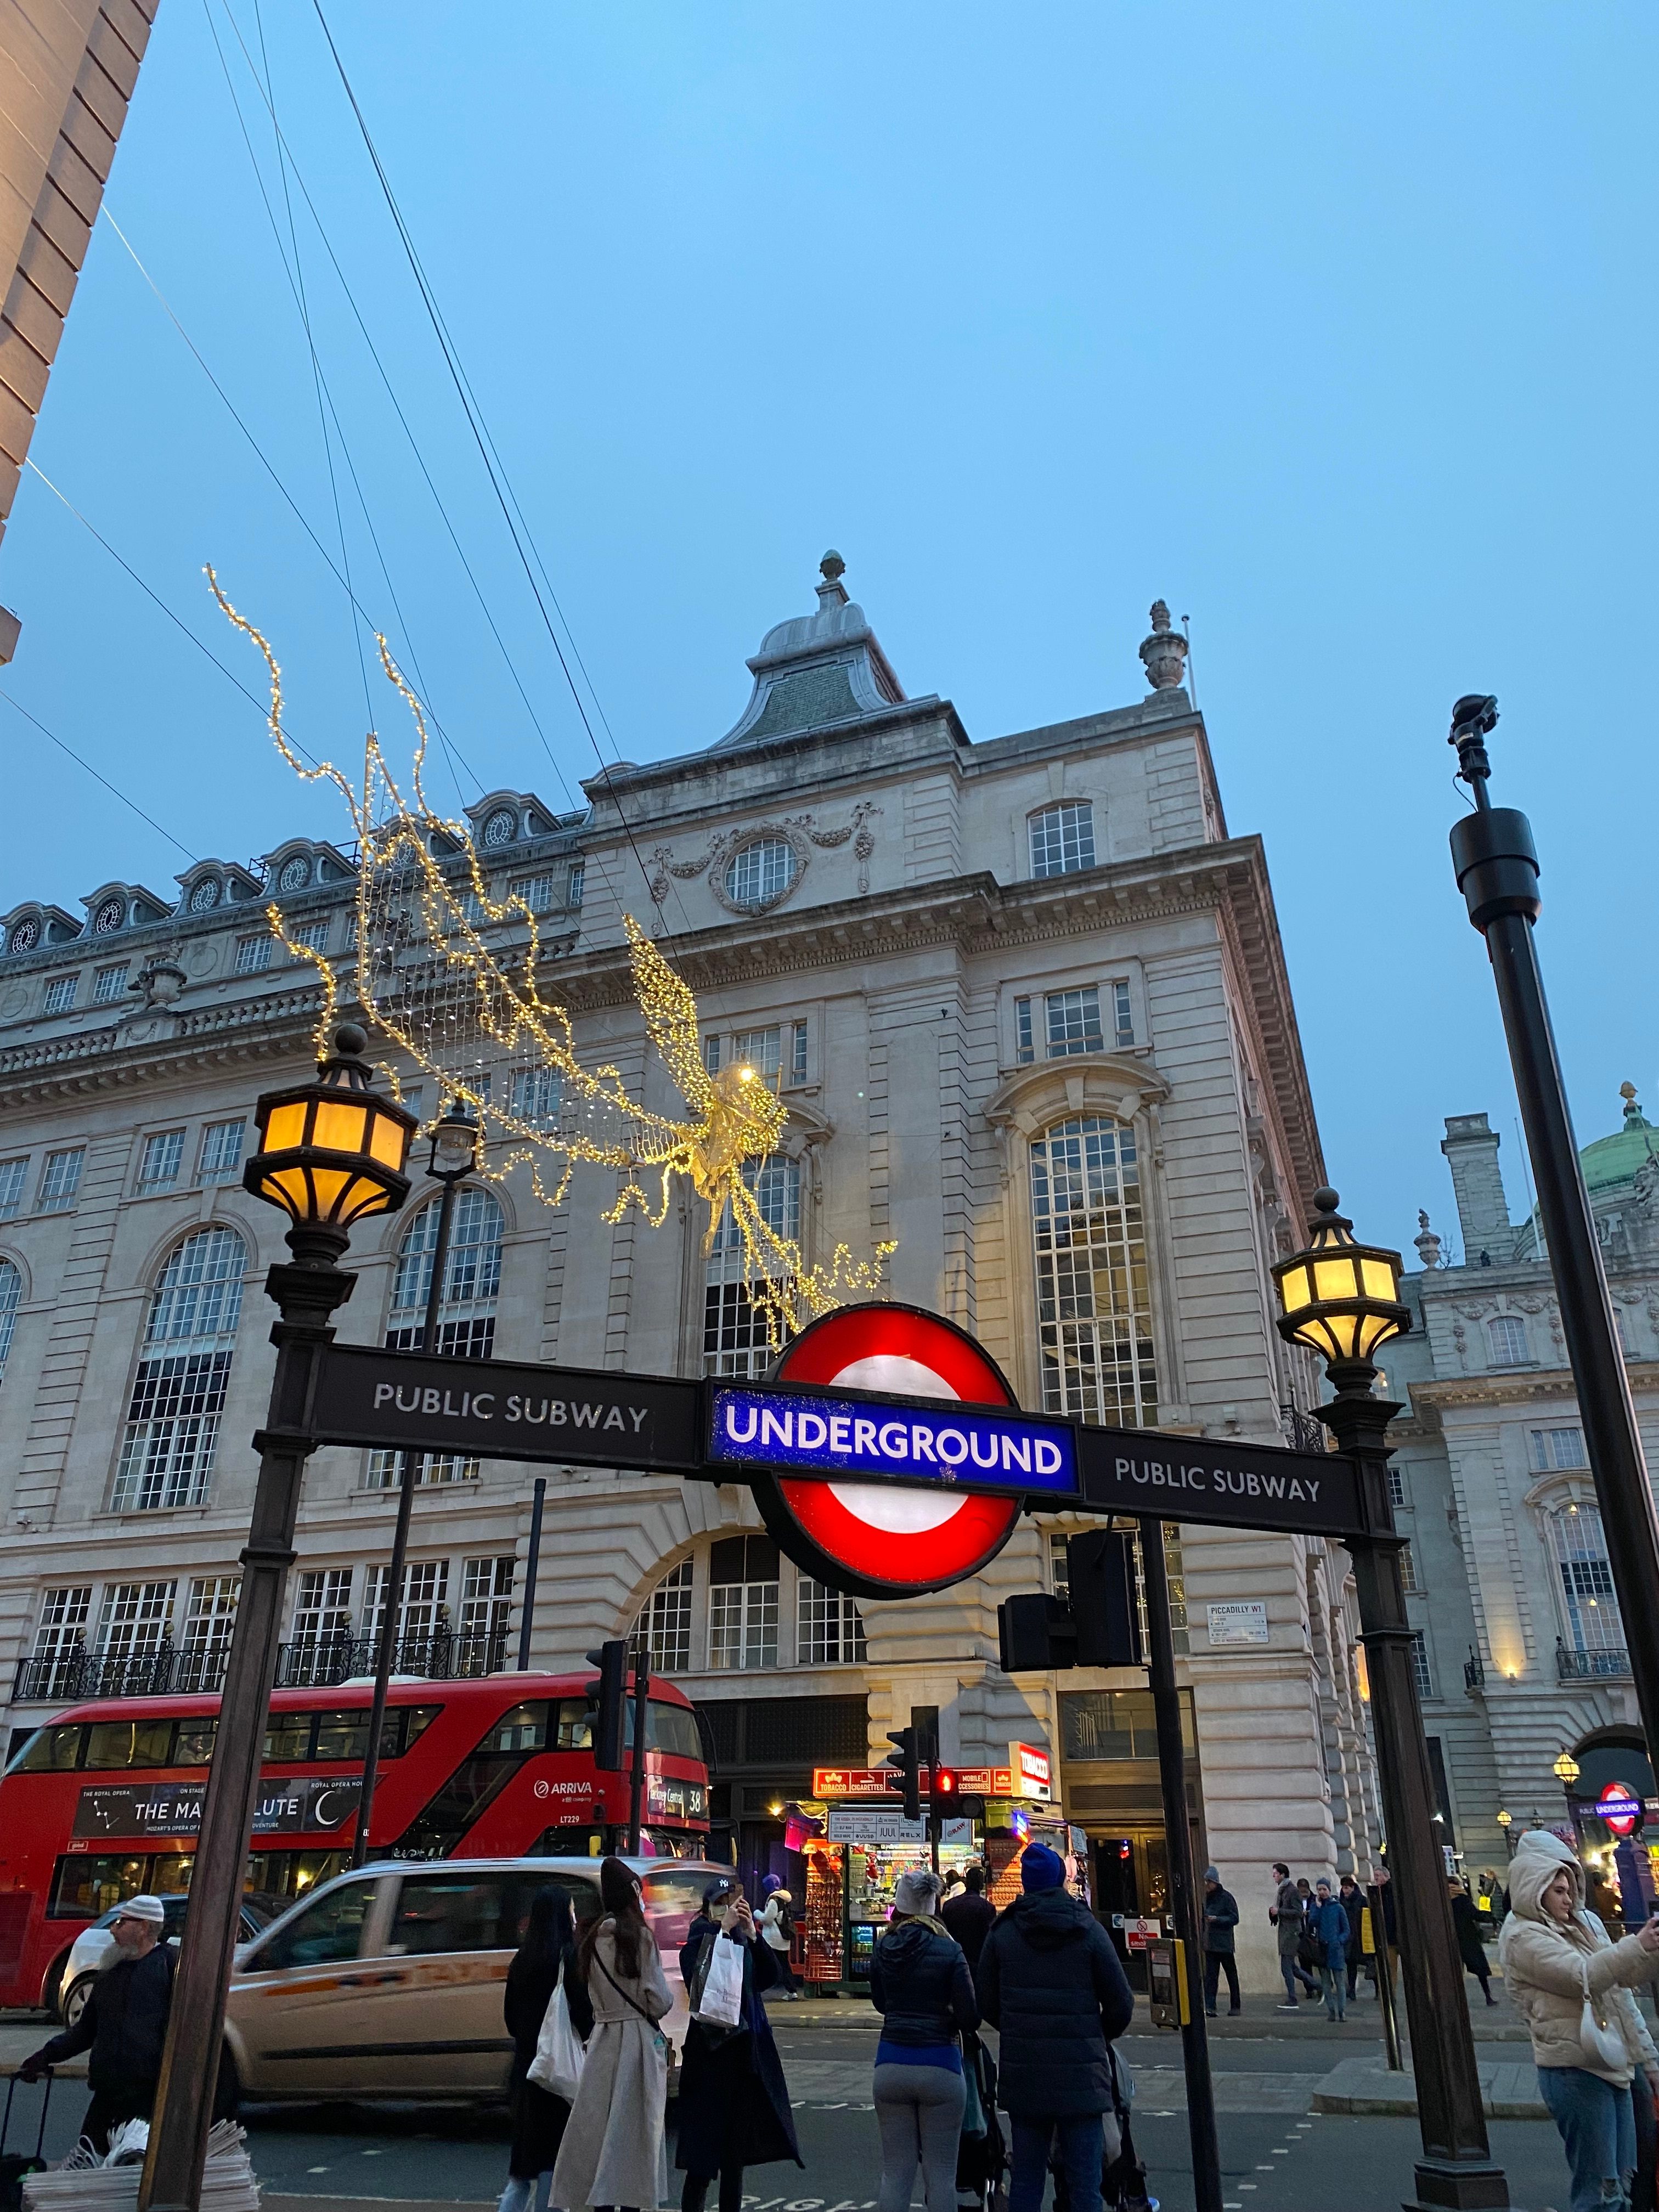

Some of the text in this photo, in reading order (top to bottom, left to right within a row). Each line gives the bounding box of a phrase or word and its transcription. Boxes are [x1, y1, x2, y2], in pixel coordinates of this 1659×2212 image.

[373, 1383, 648, 1433] PUBLIC SUBWAY
[726, 1405, 1062, 1475] UNDERGROUND
[1115, 1458, 1320, 1502] PUBLIC SUBWAY
[1211, 1606, 1249, 1614] PICCADILLY
[1020, 1751, 1048, 1780] TOBACCO
[551, 1782, 592, 1795] ARRIVA
[667, 1788, 684, 1804] Central
[820, 1784, 847, 1792] TOBACCO
[135, 1803, 170, 1820] THE
[253, 1798, 299, 1816] LUTE
[689, 1790, 701, 1813] 38
[1596, 1803, 1639, 1814] UNDERGROUND
[952, 1821, 966, 1835] RAW
